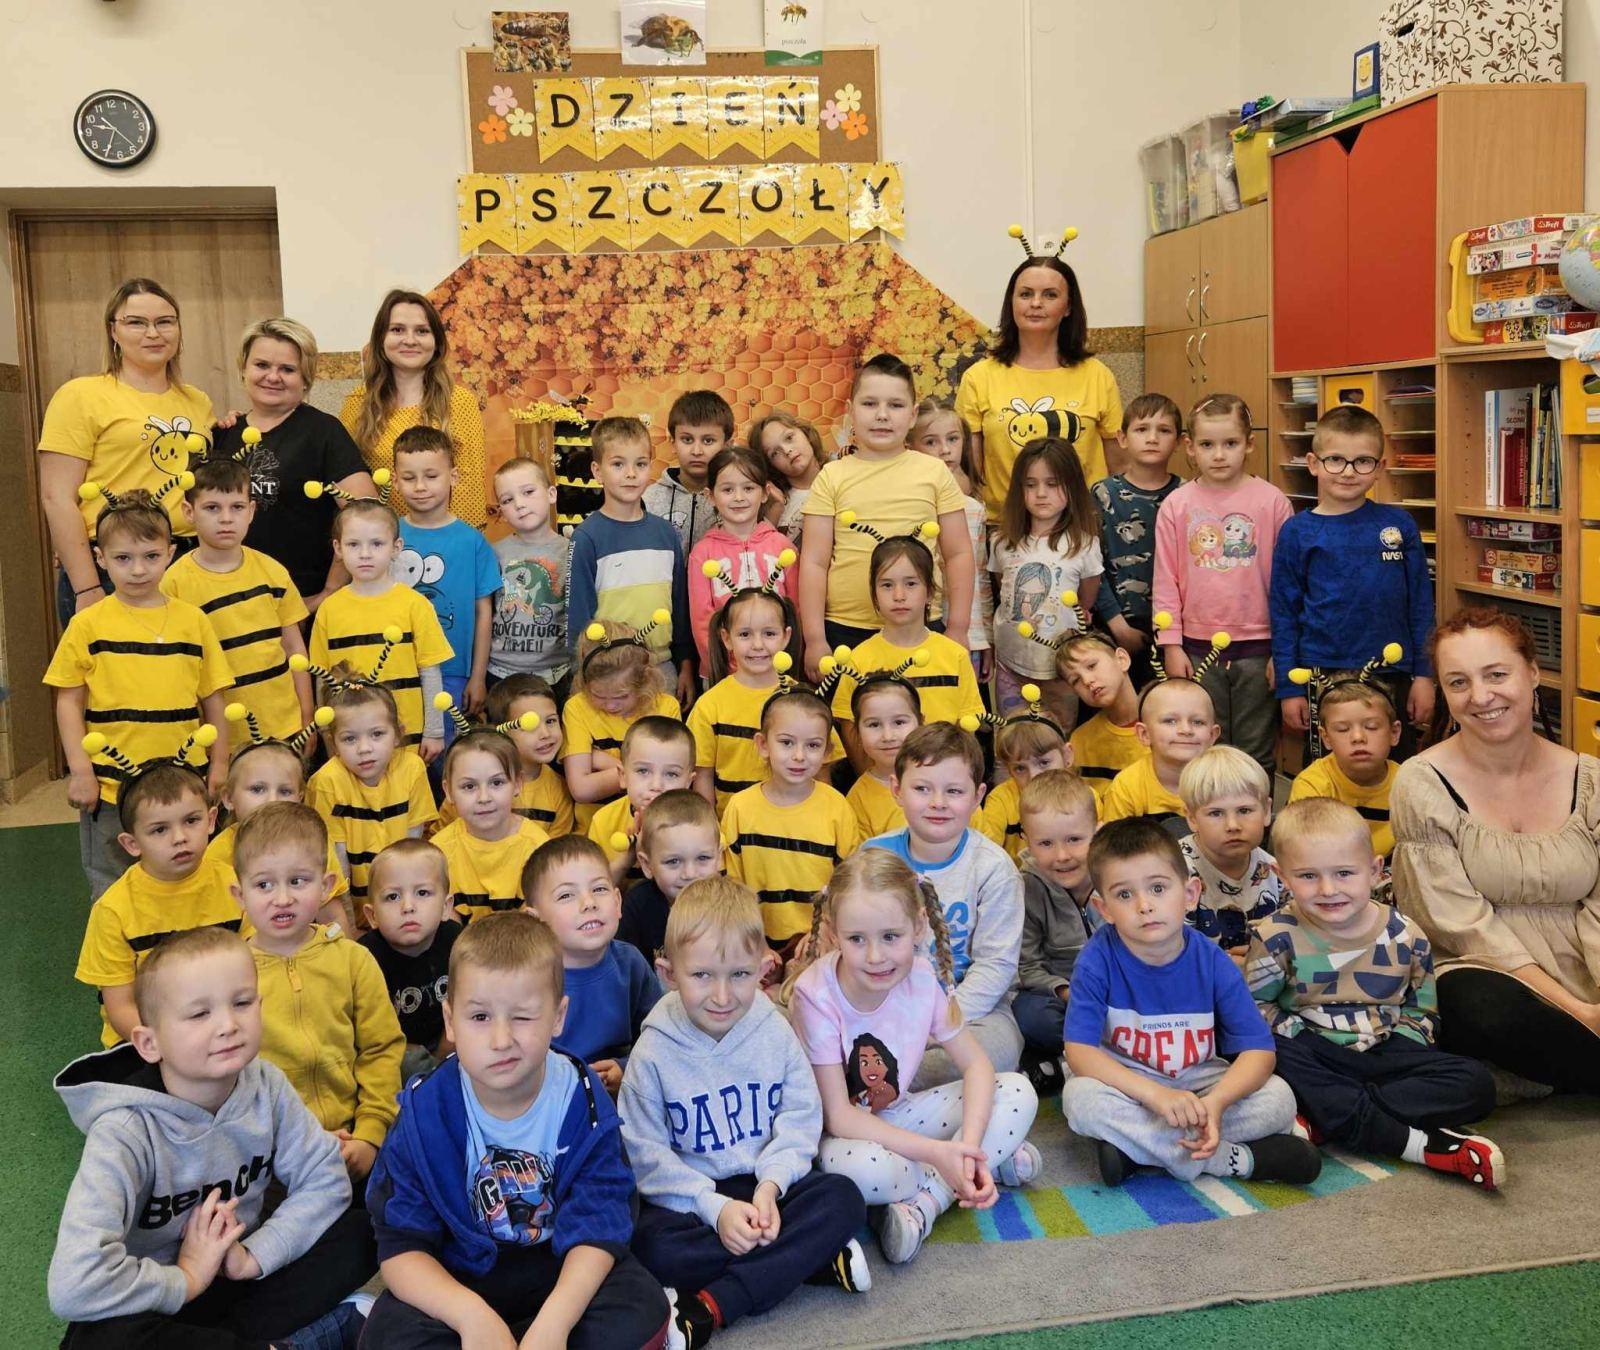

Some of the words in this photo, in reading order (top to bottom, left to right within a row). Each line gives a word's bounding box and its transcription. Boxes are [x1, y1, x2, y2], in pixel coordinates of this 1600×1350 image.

[95, 104, 103, 113] 11
[106, 100, 117, 108] 12
[123, 102, 127, 110] 1
[550, 82, 806, 128] DZIEŃ
[132, 110, 140, 119] 2
[86, 115, 96, 124] 10
[138, 122, 145, 131] 3
[85, 128, 92, 137] 9
[91, 141, 98, 149] 8
[129, 145, 137, 155] 5
[116, 151, 124, 160] 6
[474, 177, 889, 223] PSZCZOŁY
[1382, 552, 1403, 560] NASA
[1142, 1021, 1173, 1030] FRIENDS
[1174, 1020, 1191, 1028] ARE
[1110, 1026, 1214, 1074] GREAT
[664, 1082, 783, 1153] PARIS
